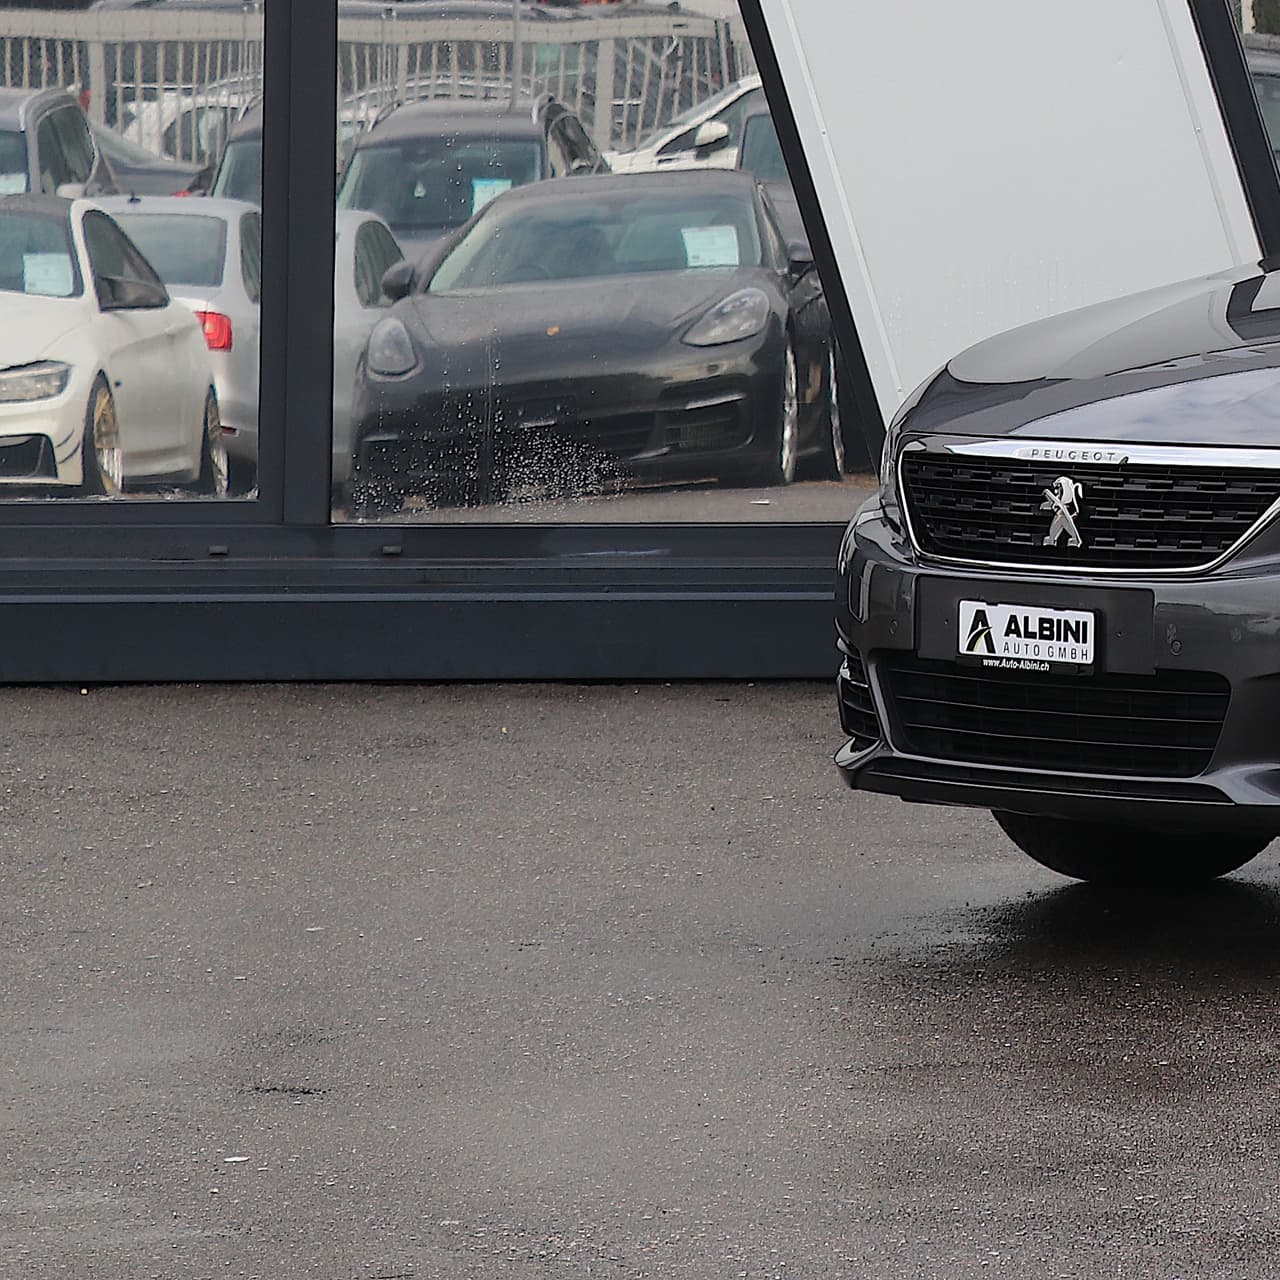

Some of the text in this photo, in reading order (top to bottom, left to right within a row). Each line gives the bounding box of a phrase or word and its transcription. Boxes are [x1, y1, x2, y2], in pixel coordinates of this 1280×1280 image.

[1031, 448, 1115, 462] PEUGEOT
[1003, 614, 1088, 644] ALBINI
[1003, 641, 1088, 661] AUTO GMBH
[982, 658, 1050, 672] www.Auto-Albini.ch
